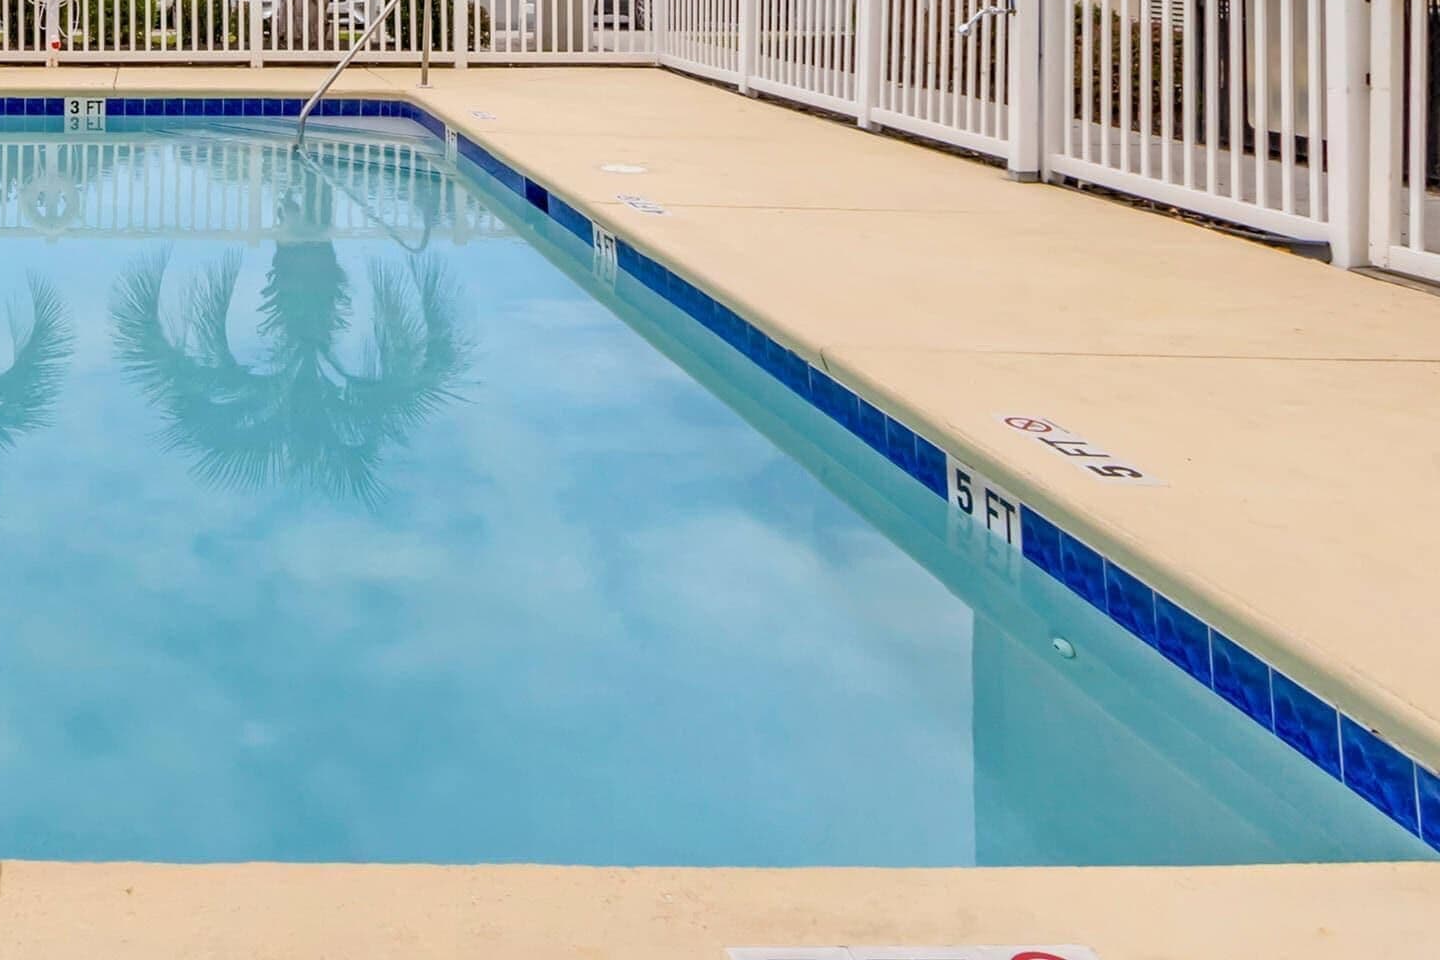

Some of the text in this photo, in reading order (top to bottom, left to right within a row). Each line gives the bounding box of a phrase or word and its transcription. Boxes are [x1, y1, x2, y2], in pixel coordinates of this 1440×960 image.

[70, 100, 104, 115] 3 FT
[1037, 436, 1111, 458] FT
[956, 468, 1015, 544] 5 FT
